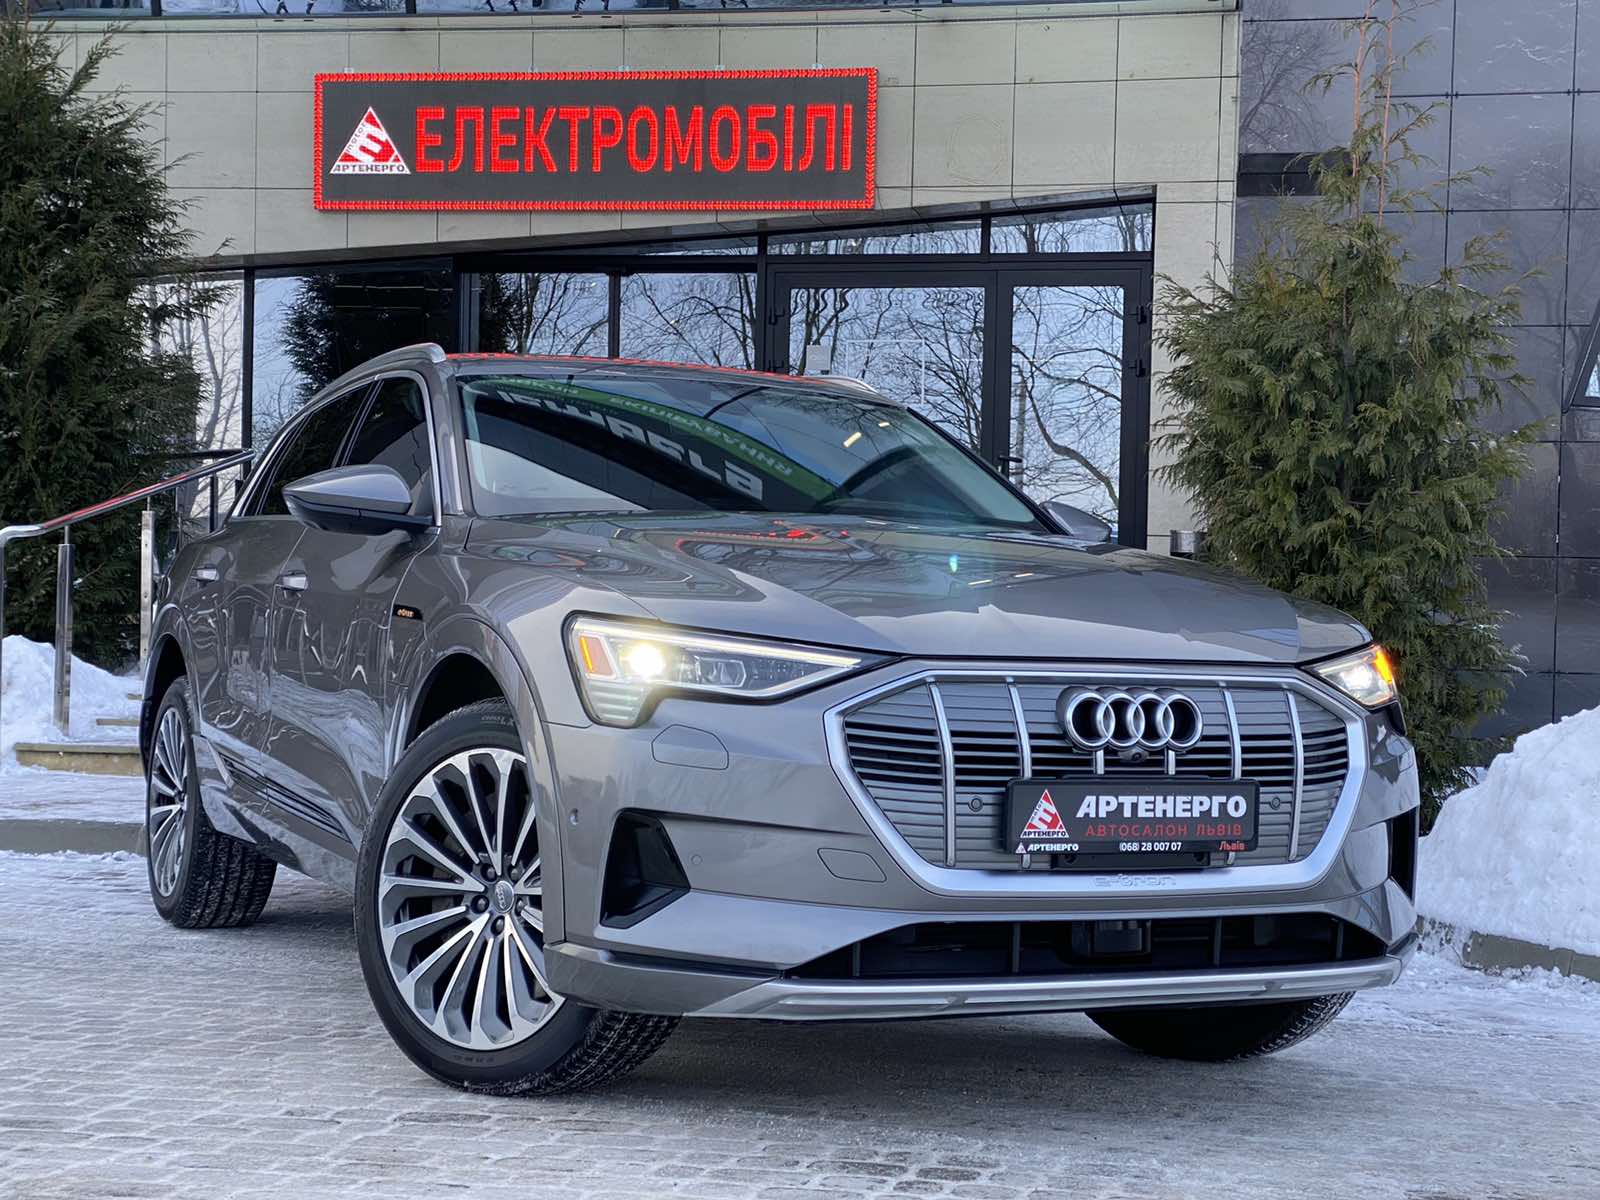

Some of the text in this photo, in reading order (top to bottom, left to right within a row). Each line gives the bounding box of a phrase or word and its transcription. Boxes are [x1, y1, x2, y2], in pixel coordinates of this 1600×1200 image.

[415, 103, 854, 174] ЕЛЕКТРОМОБІЛІ
[332, 163, 406, 173] АРТЕНЕРГО
[1075, 795, 1248, 818] АРТЕНЕРГО
[1085, 823, 1243, 837] АВТОСАЛОН ЛЬВІВ
[1027, 843, 1080, 852] АРТЕНЕРГО
[1219, 841, 1246, 851] Львів
